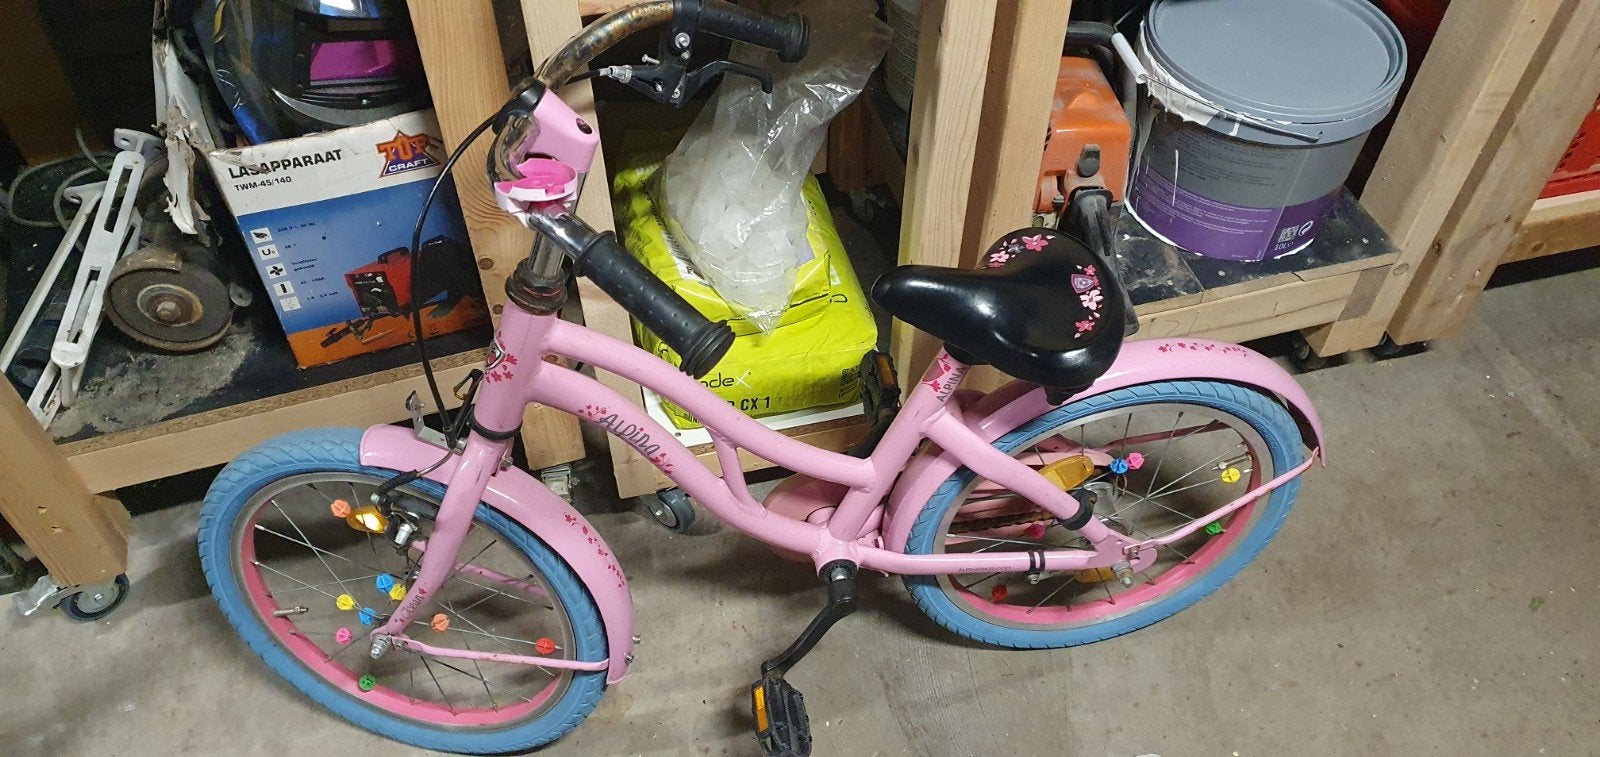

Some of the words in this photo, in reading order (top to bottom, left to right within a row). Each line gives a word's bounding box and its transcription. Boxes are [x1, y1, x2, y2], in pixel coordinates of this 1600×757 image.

[228, 149, 342, 179] LASAPPARAAT
[388, 158, 429, 172] CRAFT
[234, 176, 292, 191] TWM-45/140
[936, 367, 966, 403] ALPINA
[740, 397, 758, 411] CX
[763, 396, 770, 408] 1
[598, 413, 661, 456] Alpina
[402, 594, 425, 620] Ocean
